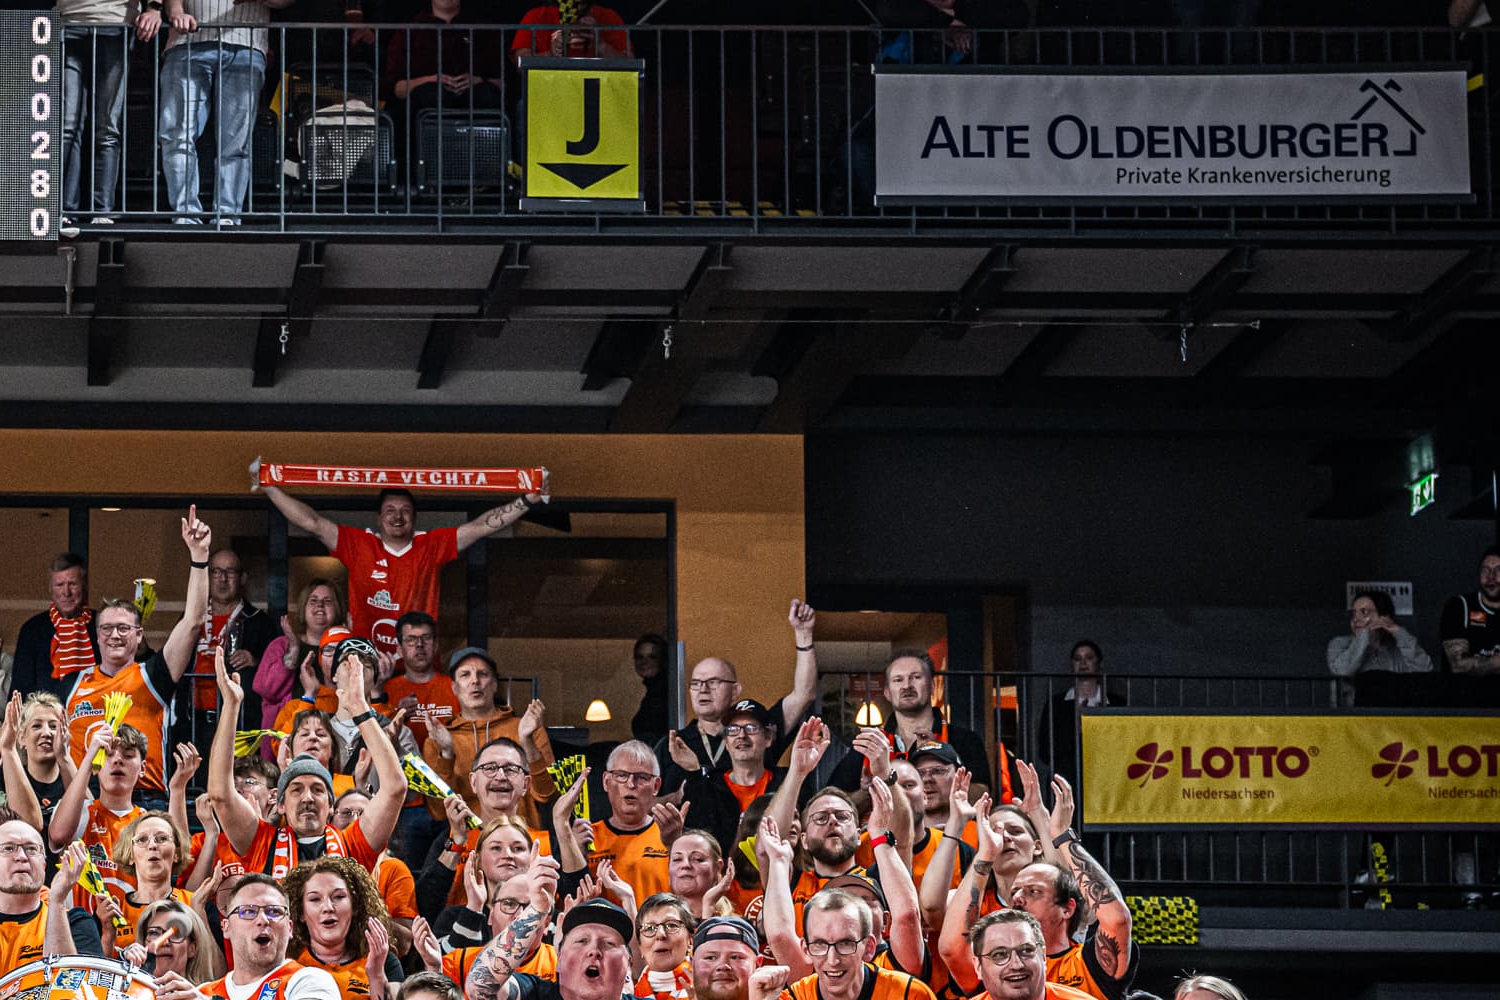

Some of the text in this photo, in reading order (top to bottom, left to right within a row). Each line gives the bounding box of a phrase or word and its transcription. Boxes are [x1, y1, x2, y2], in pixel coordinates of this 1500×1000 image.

[32, 16, 52, 45] 0
[31, 54, 52, 83] 0
[31, 92, 52, 122] 0
[566, 78, 600, 156] J
[30, 130, 52, 160] 2
[921, 114, 1389, 159] ALTE OLDENBURGER
[30, 169, 51, 199] 8
[1116, 167, 1392, 188] Private Krankenversicherung
[30, 208, 50, 237] 0
[317, 470, 488, 486] RASTA VECHTA
[377, 632, 399, 645] MIA
[1182, 787, 1276, 801] Niedersachsen
[1428, 786, 1500, 800] Niedersach
